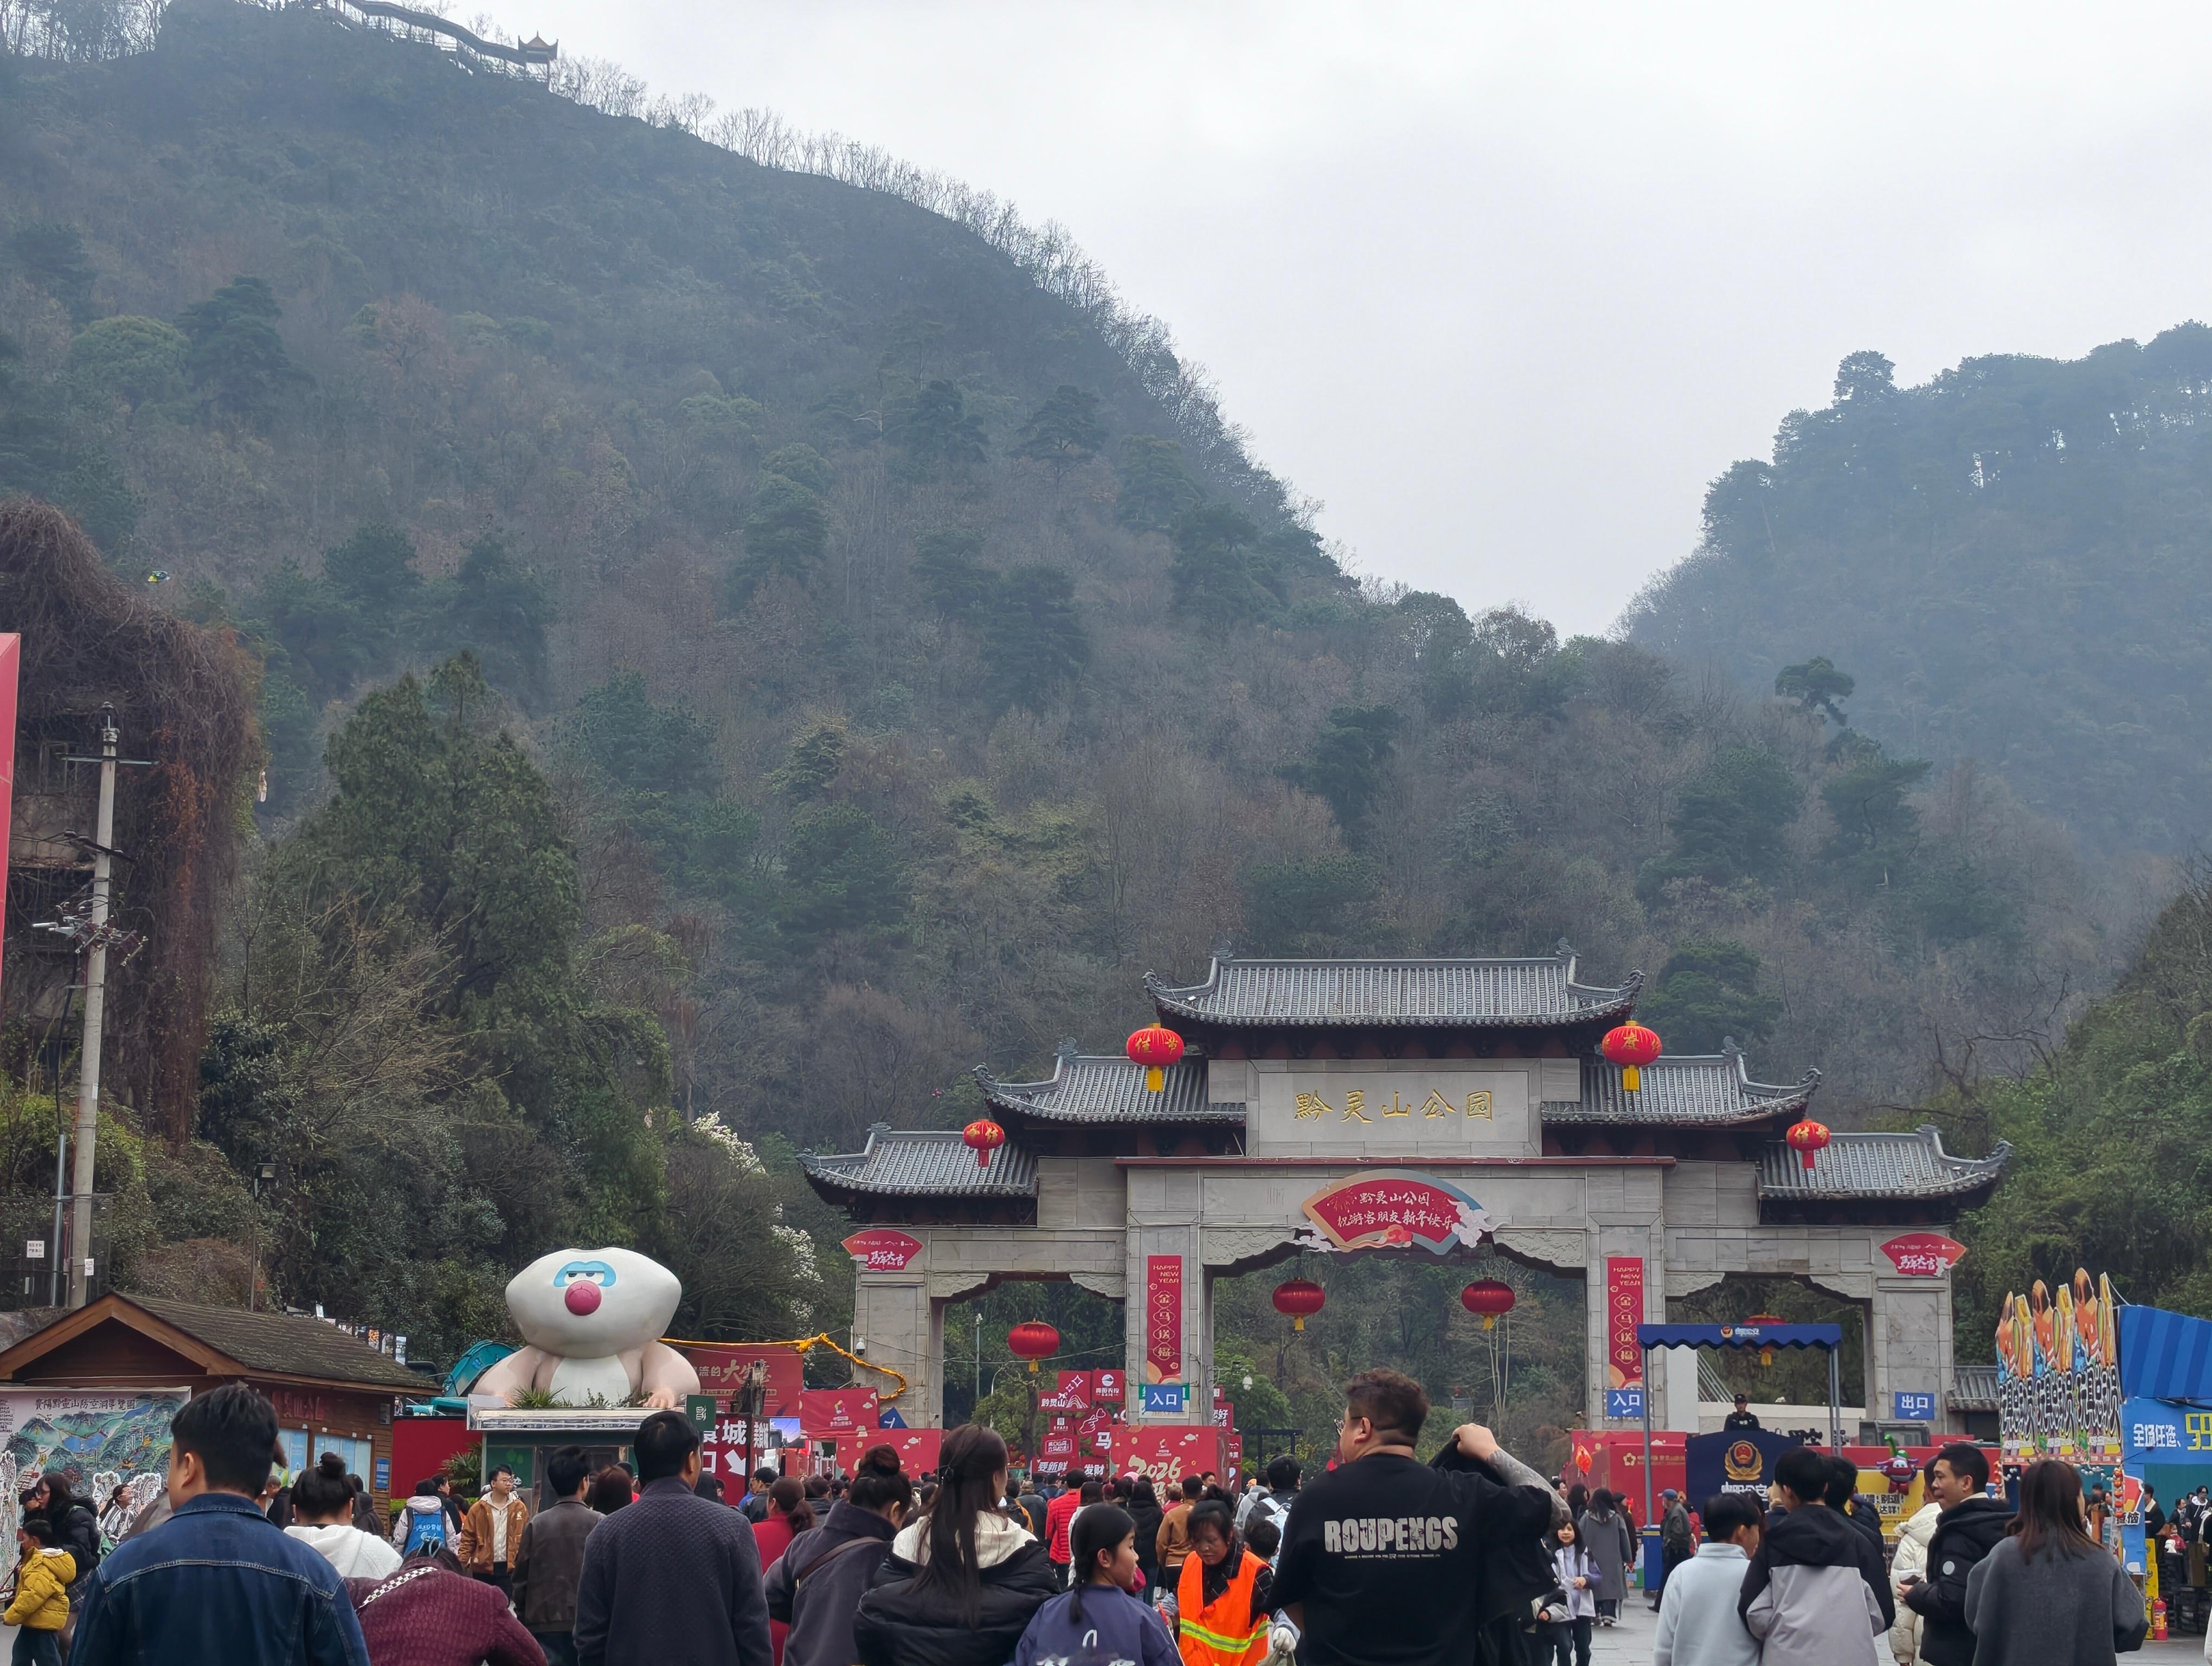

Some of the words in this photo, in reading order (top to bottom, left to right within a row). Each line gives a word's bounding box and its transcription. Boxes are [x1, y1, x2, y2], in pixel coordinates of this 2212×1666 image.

[1293, 1088, 1493, 1124] 黔灵山公园
[1360, 1190, 1430, 1207] 黔灵山公园
[1338, 1208, 1454, 1231] 祝游客朋友新年快乐
[1151, 1392, 1177, 1406] 入口
[1613, 1393, 1640, 1406] 入口
[1901, 1394, 1928, 1409] 出口
[1084, 1464, 1105, 1475] 发财
[1128, 1454, 1181, 1481] 2026
[1324, 1516, 1458, 1553] ROUPENGS
